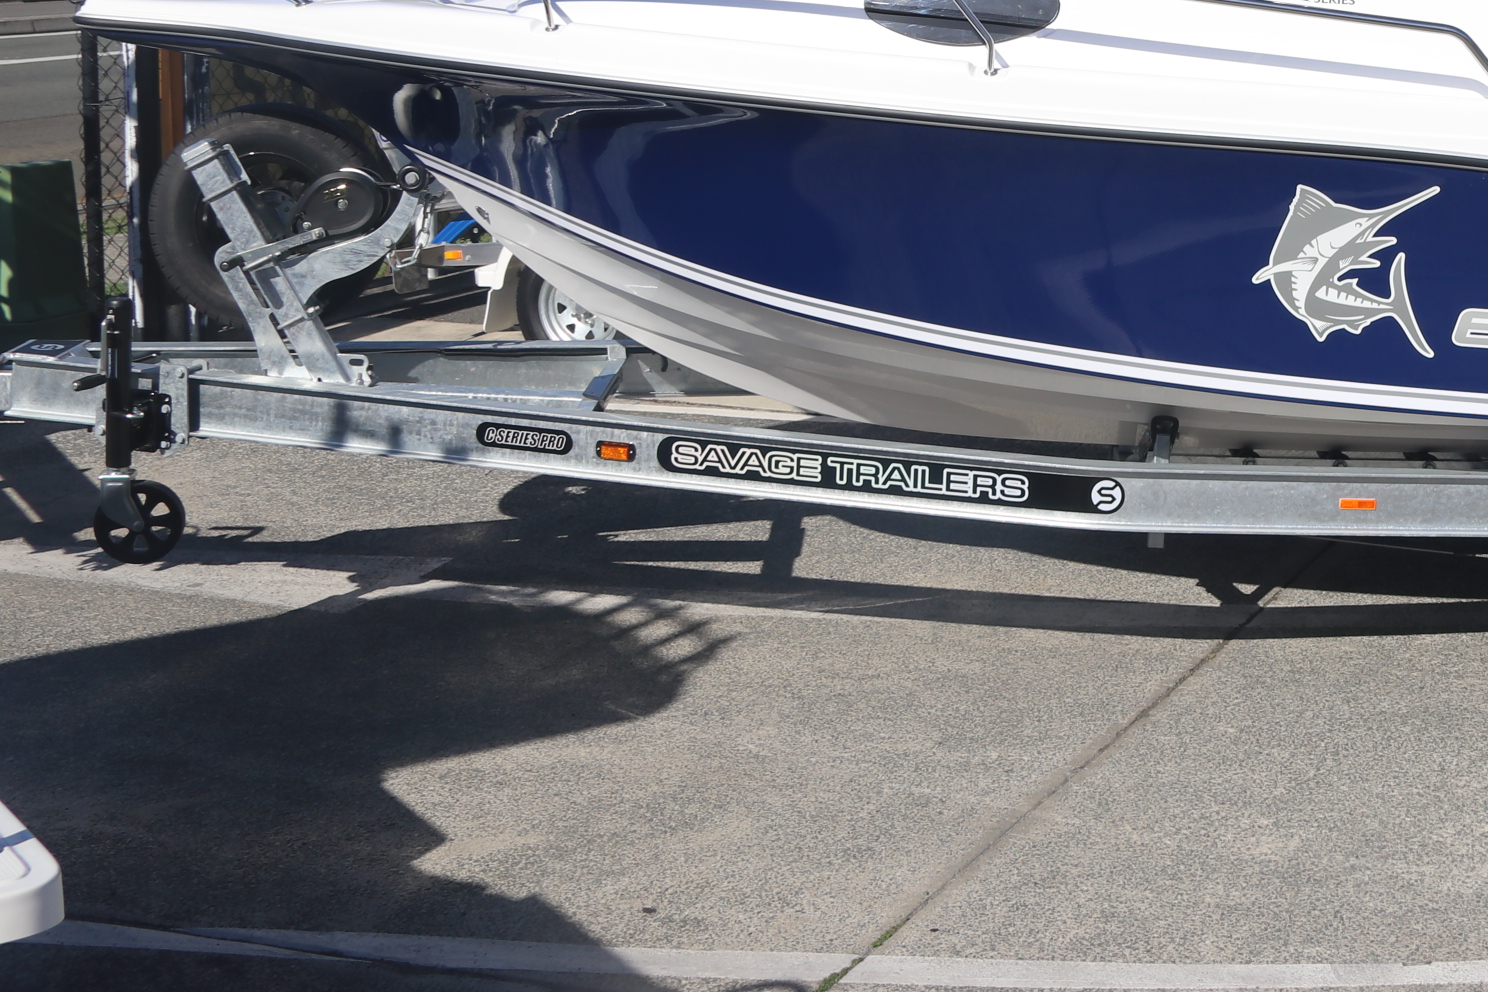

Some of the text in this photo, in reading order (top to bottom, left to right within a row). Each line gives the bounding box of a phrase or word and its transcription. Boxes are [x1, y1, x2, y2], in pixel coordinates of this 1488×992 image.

[484, 427, 566, 450] C SERIES PRO
[670, 439, 822, 483] SAVAGE
[827, 462, 1029, 504] TRAILERS
